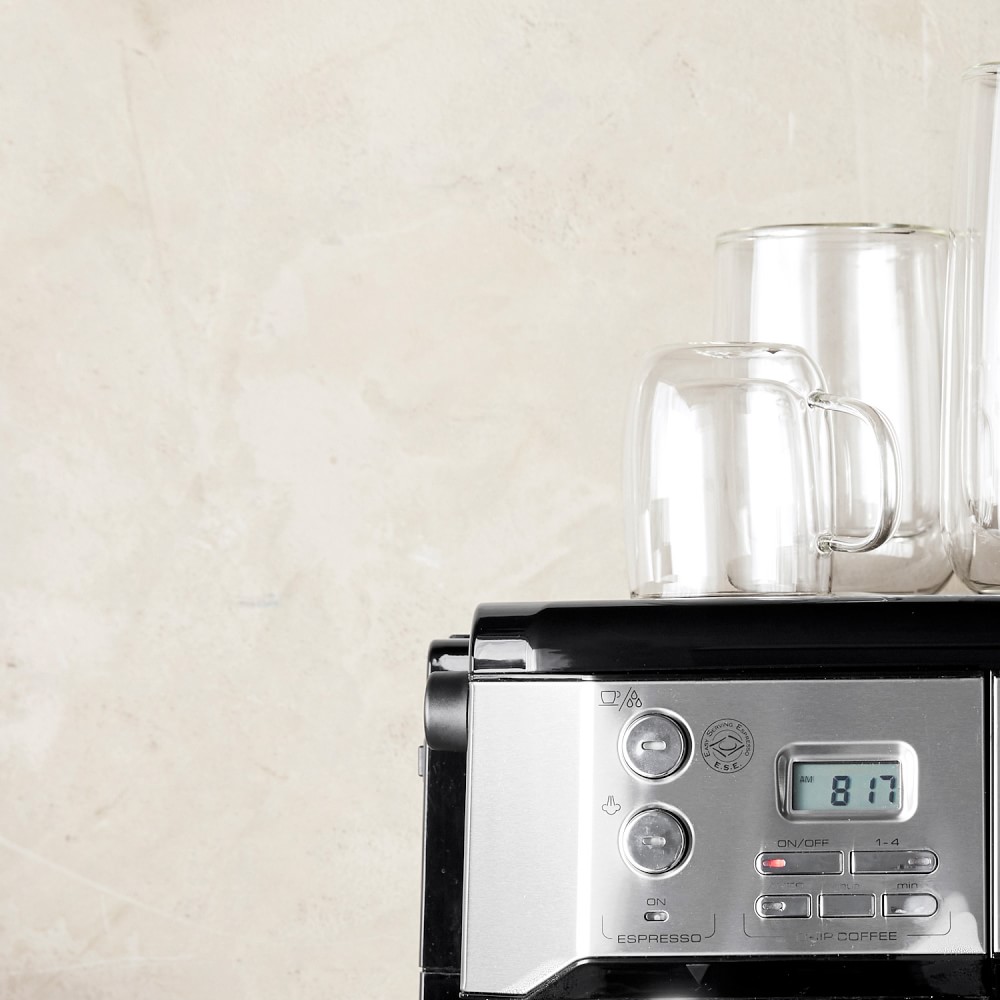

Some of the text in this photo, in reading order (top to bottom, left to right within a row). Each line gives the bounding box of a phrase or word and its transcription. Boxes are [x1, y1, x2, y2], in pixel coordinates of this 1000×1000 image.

[777, 838, 829, 848] ON/OFF
[646, 898, 666, 906] ON
[617, 934, 702, 944] ESPRESSO
[837, 931, 897, 941] COFFEE
